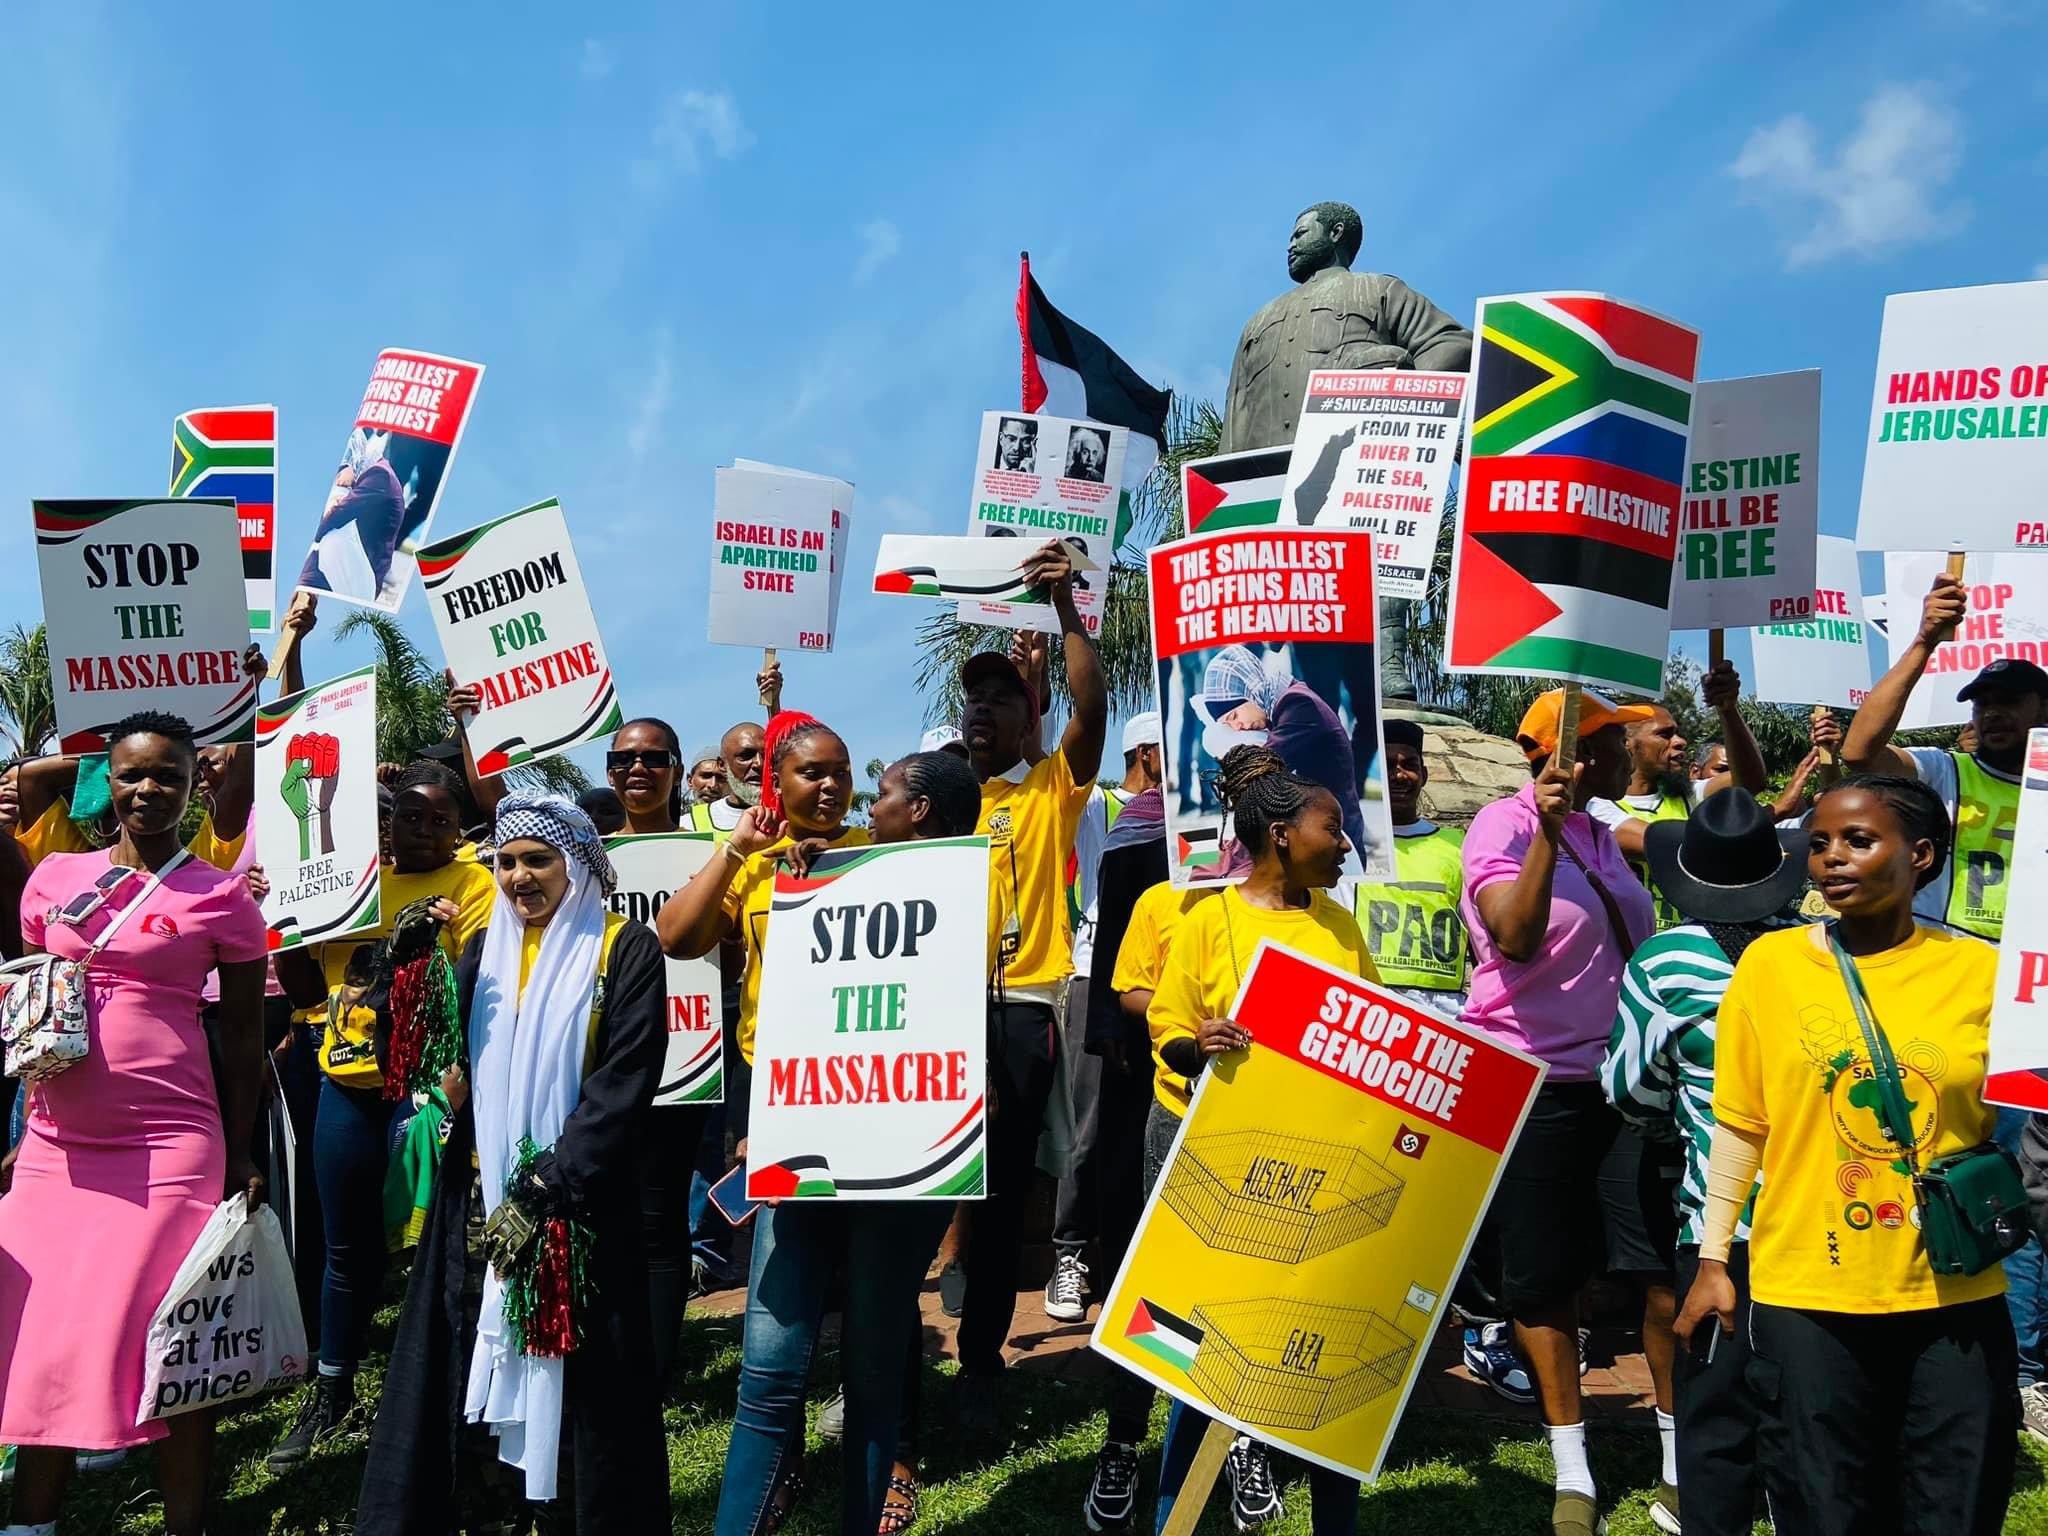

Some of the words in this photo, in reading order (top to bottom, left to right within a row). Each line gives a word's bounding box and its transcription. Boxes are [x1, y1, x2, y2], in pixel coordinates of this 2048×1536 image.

[403, 385, 444, 411] ARE
[1314, 377, 1392, 392] PALESTINE
[1393, 378, 1461, 395] RESISTS!
[1888, 367, 2001, 404] HANDS
[1360, 421, 1410, 437] FROM
[1416, 423, 1447, 439] THE
[1360, 444, 1410, 461] RIVER
[1416, 447, 1437, 463] TO
[1357, 468, 1386, 485] THE
[1391, 470, 1427, 490] SEA,
[1687, 453, 1800, 493] ESTINE
[978, 502, 1015, 524] FREE
[1018, 507, 1108, 536] PALESTINE!
[1342, 492, 1433, 513] PALESTINE
[1489, 480, 1560, 512] FREE
[1566, 481, 1672, 538] PALESTINE
[1740, 493, 1779, 526] BE
[717, 521, 776, 546] ISRAEL
[780, 528, 797, 548] IS
[801, 531, 824, 551] AN
[1395, 520, 1417, 536] BE
[83, 543, 199, 588] STOP
[720, 545, 817, 573] APARTHEID
[1170, 548, 1211, 584] THE
[1216, 540, 1347, 574] SMALLEST
[1679, 528, 1776, 580] REE
[442, 551, 567, 624] FREEDOM
[744, 570, 794, 593] STATE
[1180, 572, 1283, 613] COFFINS
[1289, 572, 1339, 601] ARE
[114, 604, 184, 639] THE
[1176, 610, 1217, 645] THE
[1222, 603, 1346, 636] HEAVIEST
[1770, 597, 1810, 617] PAO
[489, 611, 547, 657] FOR
[800, 632, 824, 647] PAO
[65, 650, 240, 692] MASSACRE
[334, 698, 352, 711] ISRAEL
[279, 871, 354, 906] PALESTINE
[299, 859, 333, 882] FREE
[811, 899, 937, 964] STOP
[1367, 900, 1461, 963] PAO
[1965, 908, 1997, 918] PEOPLE
[832, 983, 907, 1032] THE
[1319, 985, 1411, 1049] STOP
[1412, 1025, 1475, 1081] THE
[768, 1051, 967, 1106] MASSACRE
[1299, 1022, 1462, 1121] GENOCIDE
[1847, 1130, 1859, 1144] FOR
[1240, 1156, 1327, 1208] AUSCHWITZ
[163, 1331, 200, 1367] at
[211, 1322, 264, 1361] firs
[1282, 1329, 1325, 1373] GAZA
[152, 1368, 251, 1416] price
